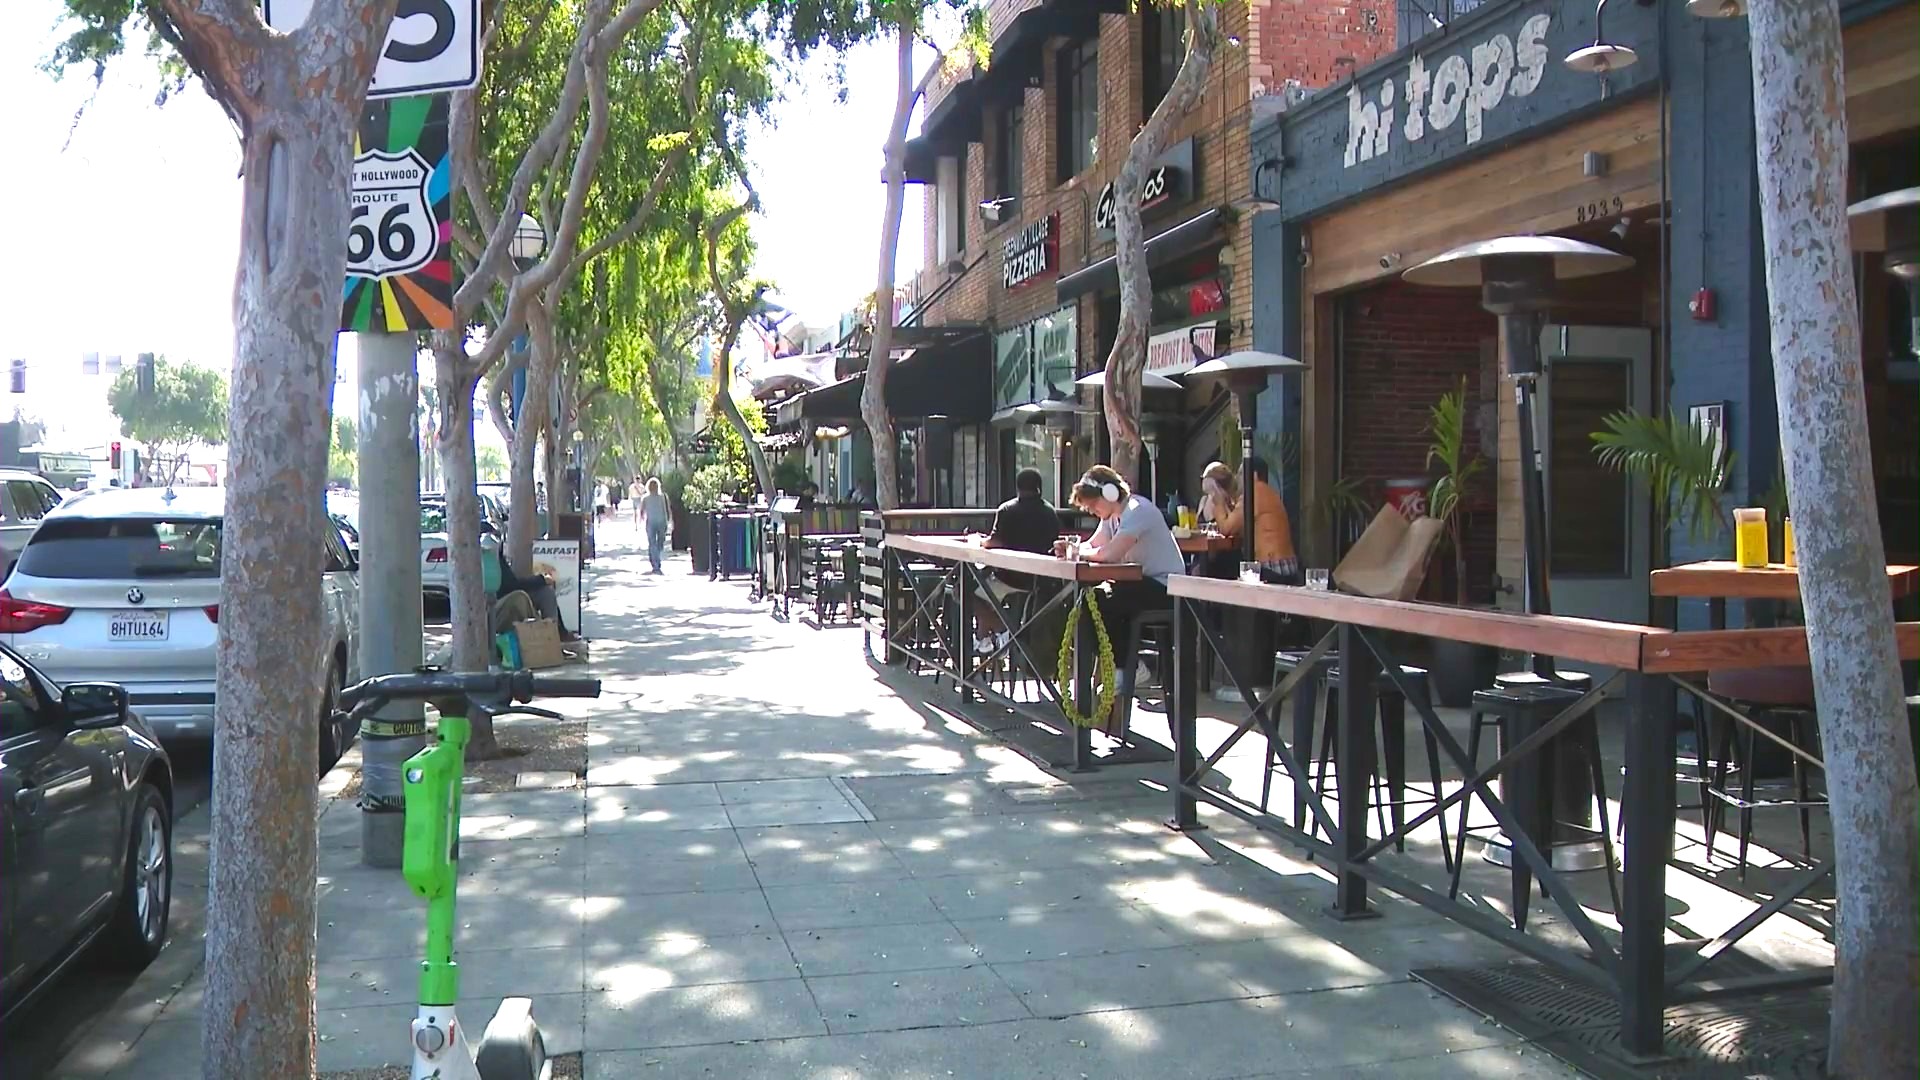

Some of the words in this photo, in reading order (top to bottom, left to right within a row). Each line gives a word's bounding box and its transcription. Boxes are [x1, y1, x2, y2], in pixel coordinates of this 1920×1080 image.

[384, 0, 455, 63] 5
[1343, 78, 1395, 169] hi
[1404, 14, 1551, 145] tops
[361, 169, 419, 182] HOLLYWOOD
[352, 193, 399, 204] ROUTE
[1577, 196, 1623, 223] 8939
[347, 203, 416, 263] 66
[1026, 215, 1049, 247] VILLAGE
[1003, 242, 1046, 289] PIZZERIA
[1181, 328, 1214, 365] BURITOS
[533, 546, 578, 555] EAKFAST
[111, 621, 164, 637] 8HTU164
